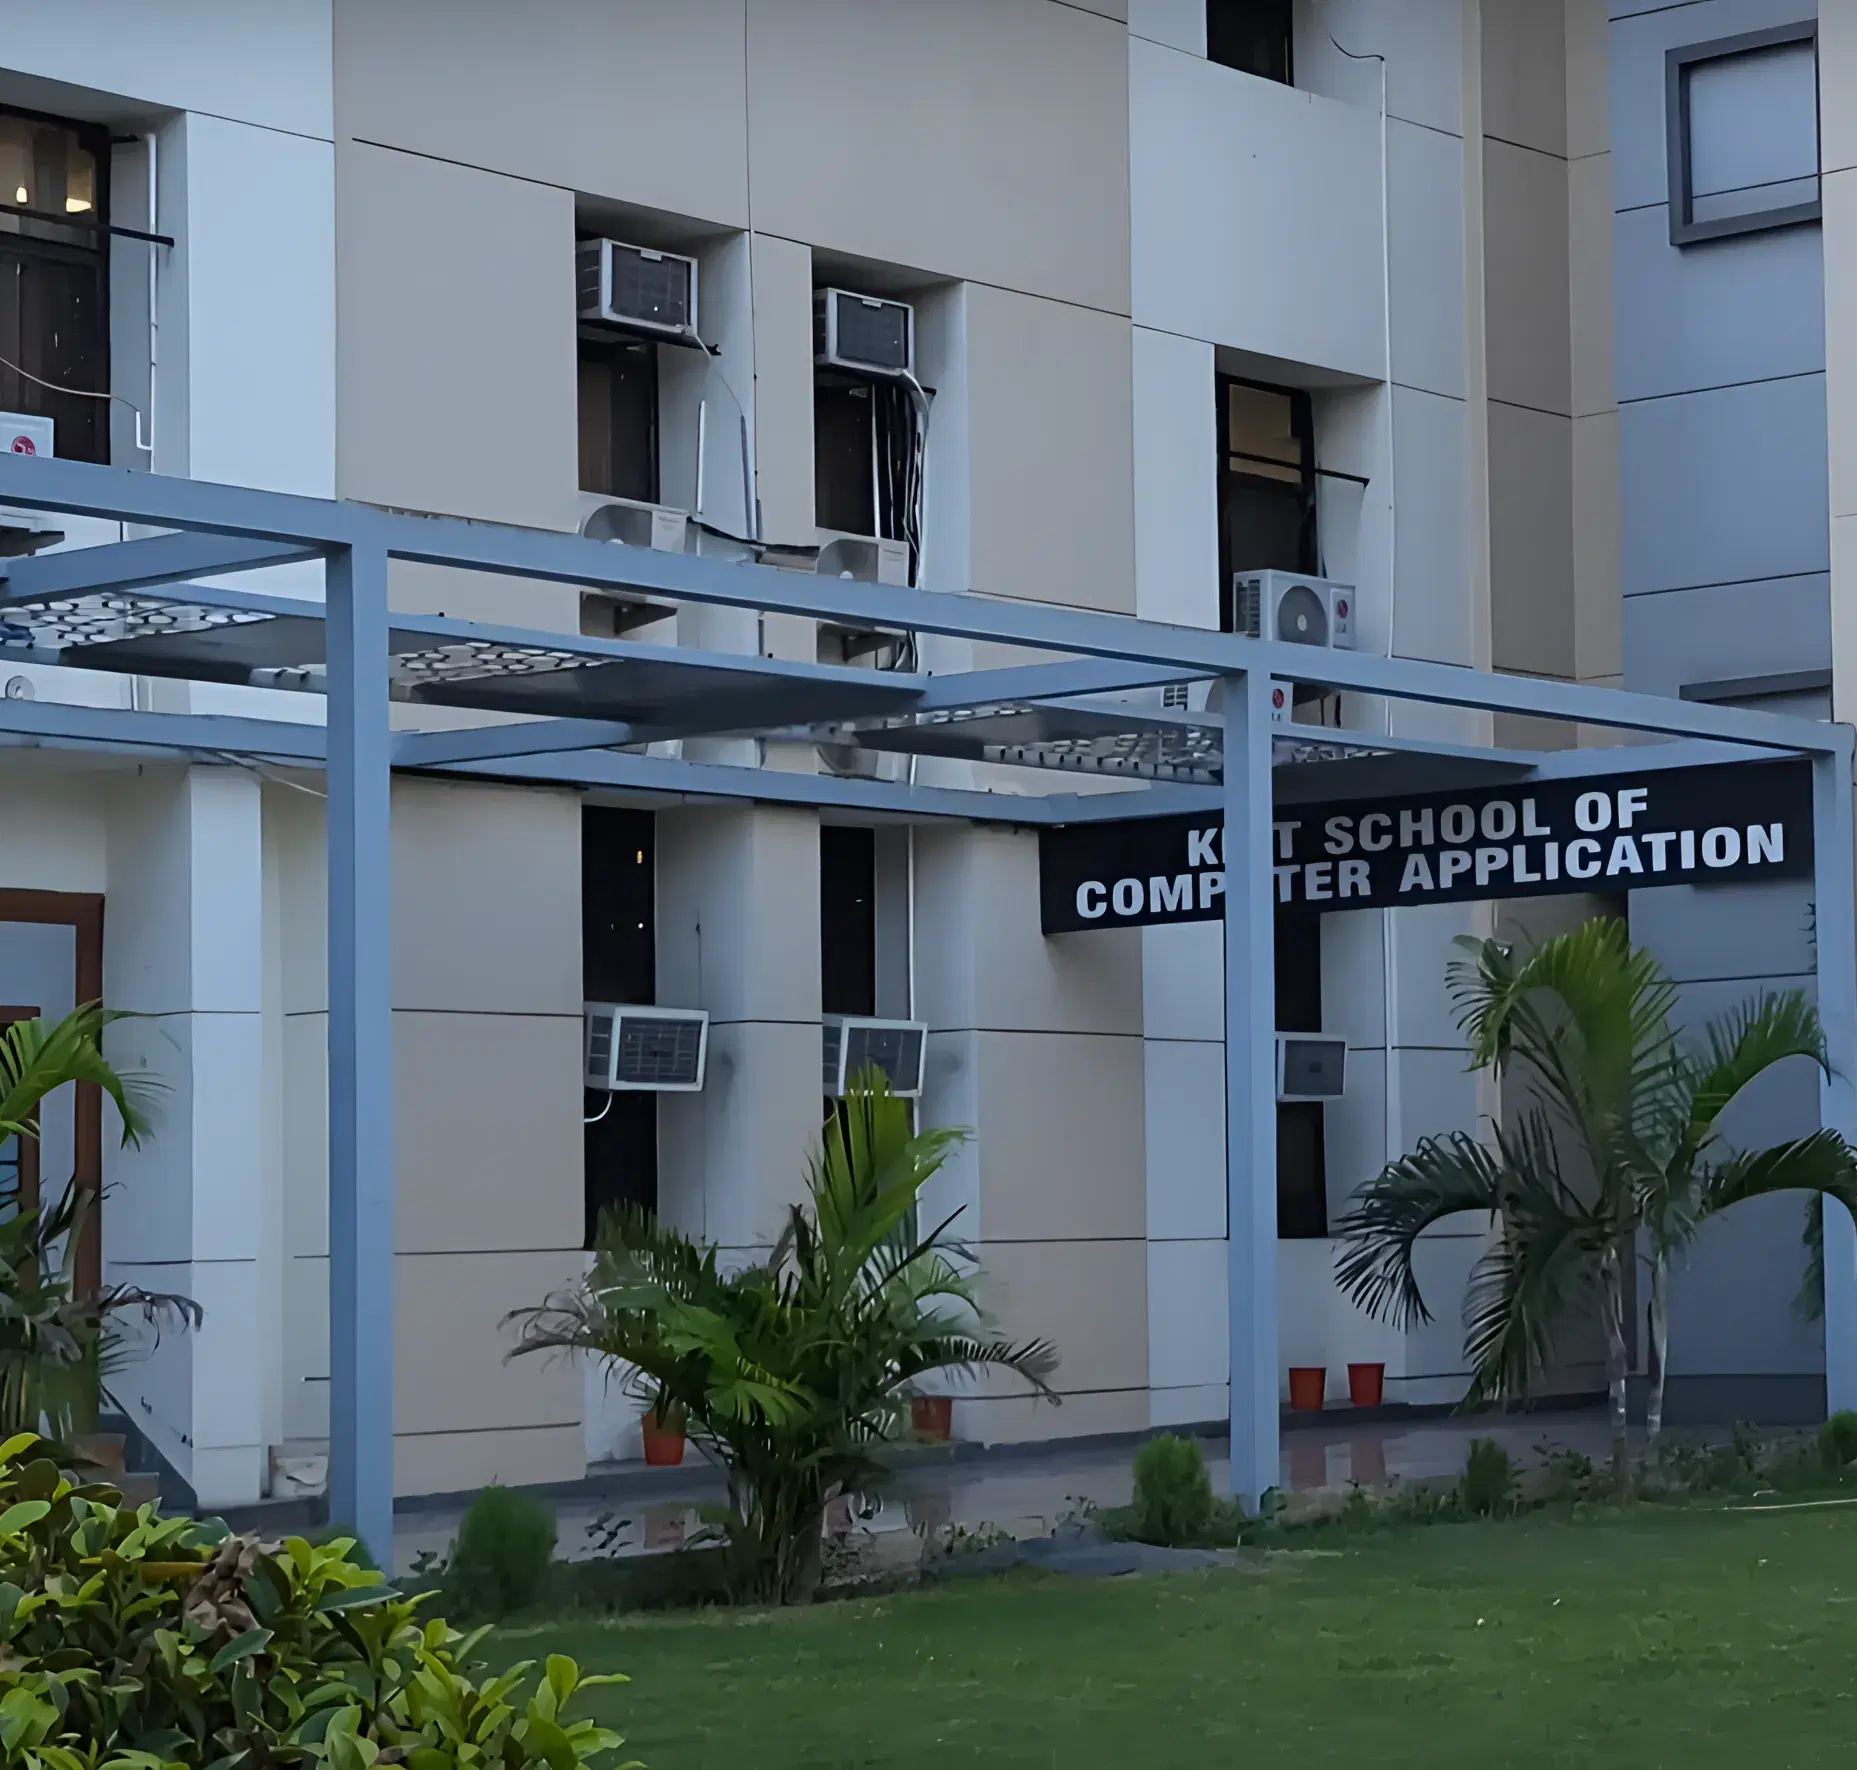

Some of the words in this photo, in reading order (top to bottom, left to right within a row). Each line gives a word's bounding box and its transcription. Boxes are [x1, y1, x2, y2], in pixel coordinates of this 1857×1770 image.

[1076, 859, 1372, 919] COMPTER
[1398, 823, 1784, 892] APPLICATION
[1187, 821, 1302, 867] KT
[1323, 798, 1551, 856] SCHOOL
[1574, 787, 1648, 833] OF
